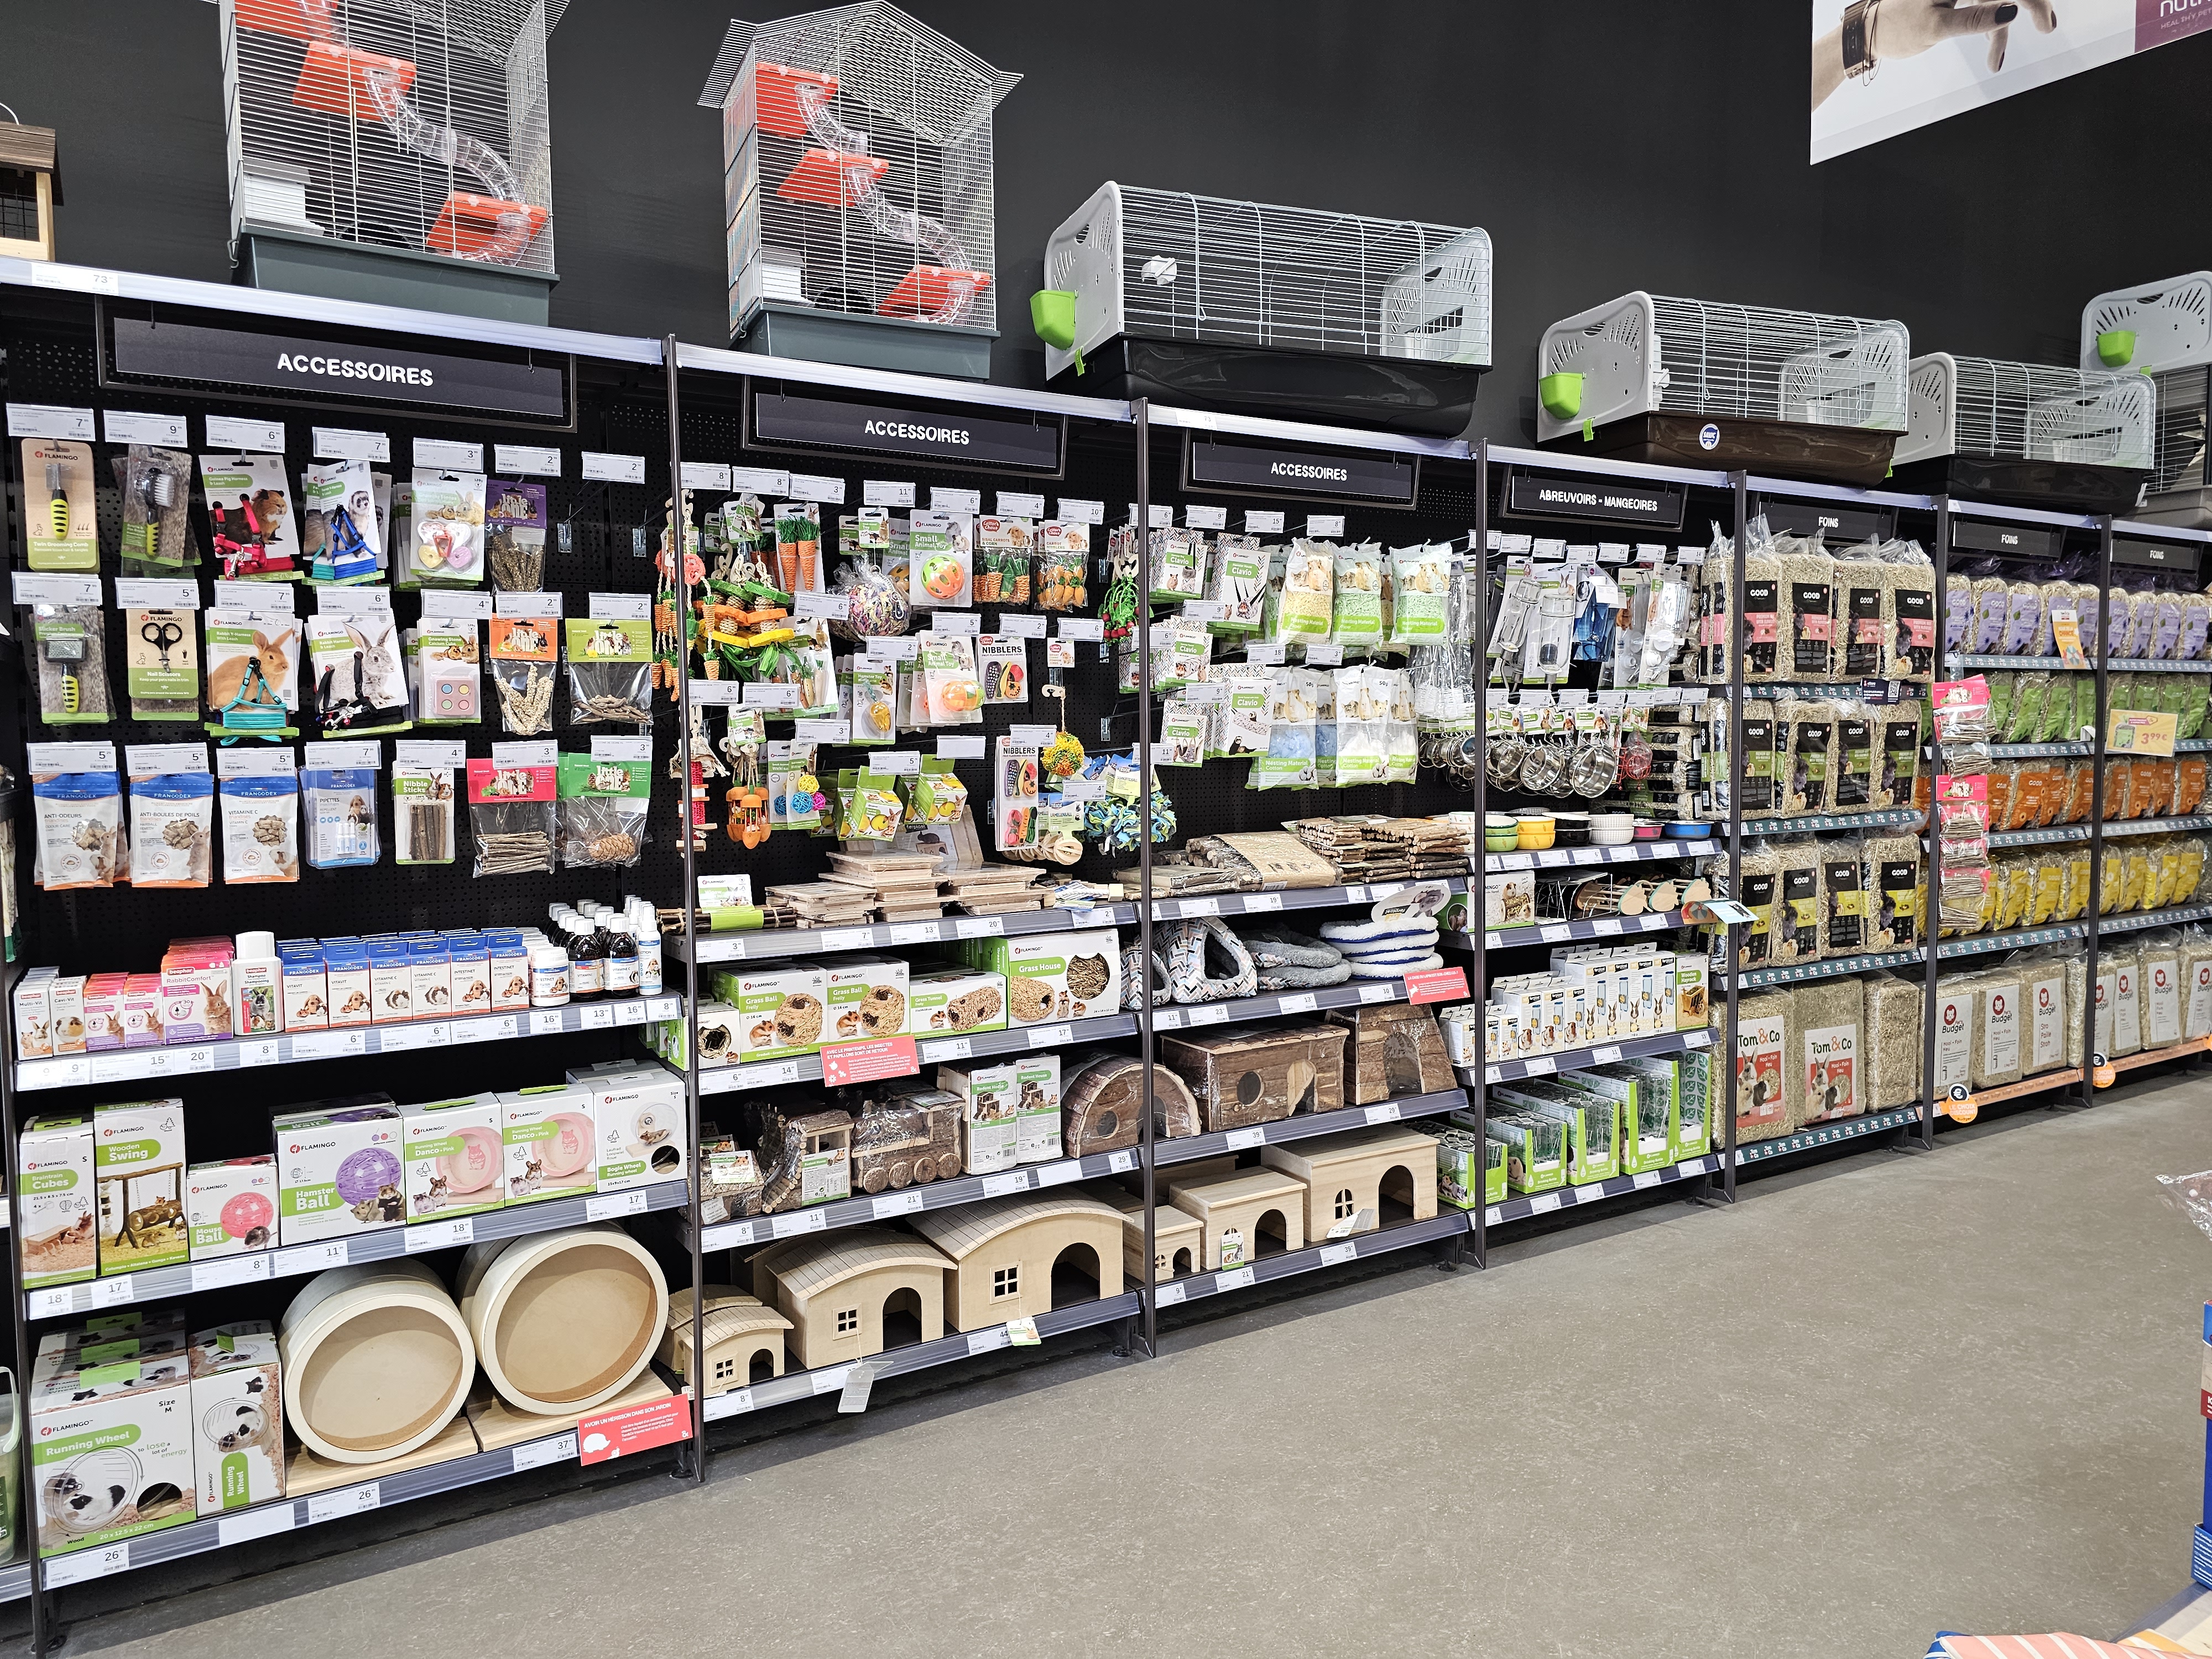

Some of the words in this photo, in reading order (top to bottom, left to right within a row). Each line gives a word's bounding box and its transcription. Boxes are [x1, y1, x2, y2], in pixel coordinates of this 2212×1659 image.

[278, 354, 433, 387] ACCESSOIRES
[76, 419, 82, 427] 7
[864, 420, 969, 445] ACCESSOIRES
[1271, 462, 1348, 481] ACCESSOIRES
[1540, 489, 1597, 505] ABREUVOIRS
[1604, 496, 1657, 511] MANGEOIRES
[1819, 517, 1839, 528] FOINS
[2001, 534, 2018, 545] FOINS
[2150, 550, 2164, 559] FOINS
[1232, 567, 1251, 576] Clavio
[594, 630, 622, 642] little
[2141, 733, 2149, 744] 3
[1019, 964, 1038, 973] Grass
[1039, 962, 1061, 971] House
[166, 975, 211, 984] RabbitComfort
[1992, 1013, 2012, 1023] Budget
[1942, 1023, 1964, 1034] Budget
[1738, 1034, 1758, 1047] Tom
[1770, 1030, 1780, 1042] Co
[1812, 1041, 1830, 1053] Tom
[1841, 1039, 1851, 1050] Co
[191, 1052, 204, 1061] 20
[512, 1132, 535, 1140] Danco
[109, 1143, 140, 1152] Wooden
[301, 1142, 336, 1151] FLAMINGO
[109, 1149, 148, 1161] Swing
[32, 1172, 63, 1181] Braintrain
[32, 1178, 69, 1190] Cubes
[296, 1187, 335, 1198] Hamster
[296, 1196, 330, 1211] Ball
[196, 1227, 222, 1235] Mouse
[196, 1232, 222, 1244] Ball
[326, 1248, 338, 1256] 11
[109, 1283, 122, 1292] 17
[48, 1294, 62, 1304] 18
[159, 1399, 175, 1407] Size
[607, 1412, 631, 1422] HÉRISSON
[655, 1402, 671, 1411] JARDIN
[46, 1439, 93, 1457] Running
[96, 1432, 130, 1448] Wheel
[147, 1441, 166, 1450] lose
[557, 1440, 569, 1449] 37
[161, 1448, 187, 1459] energy
[105, 1552, 119, 1561] 26
